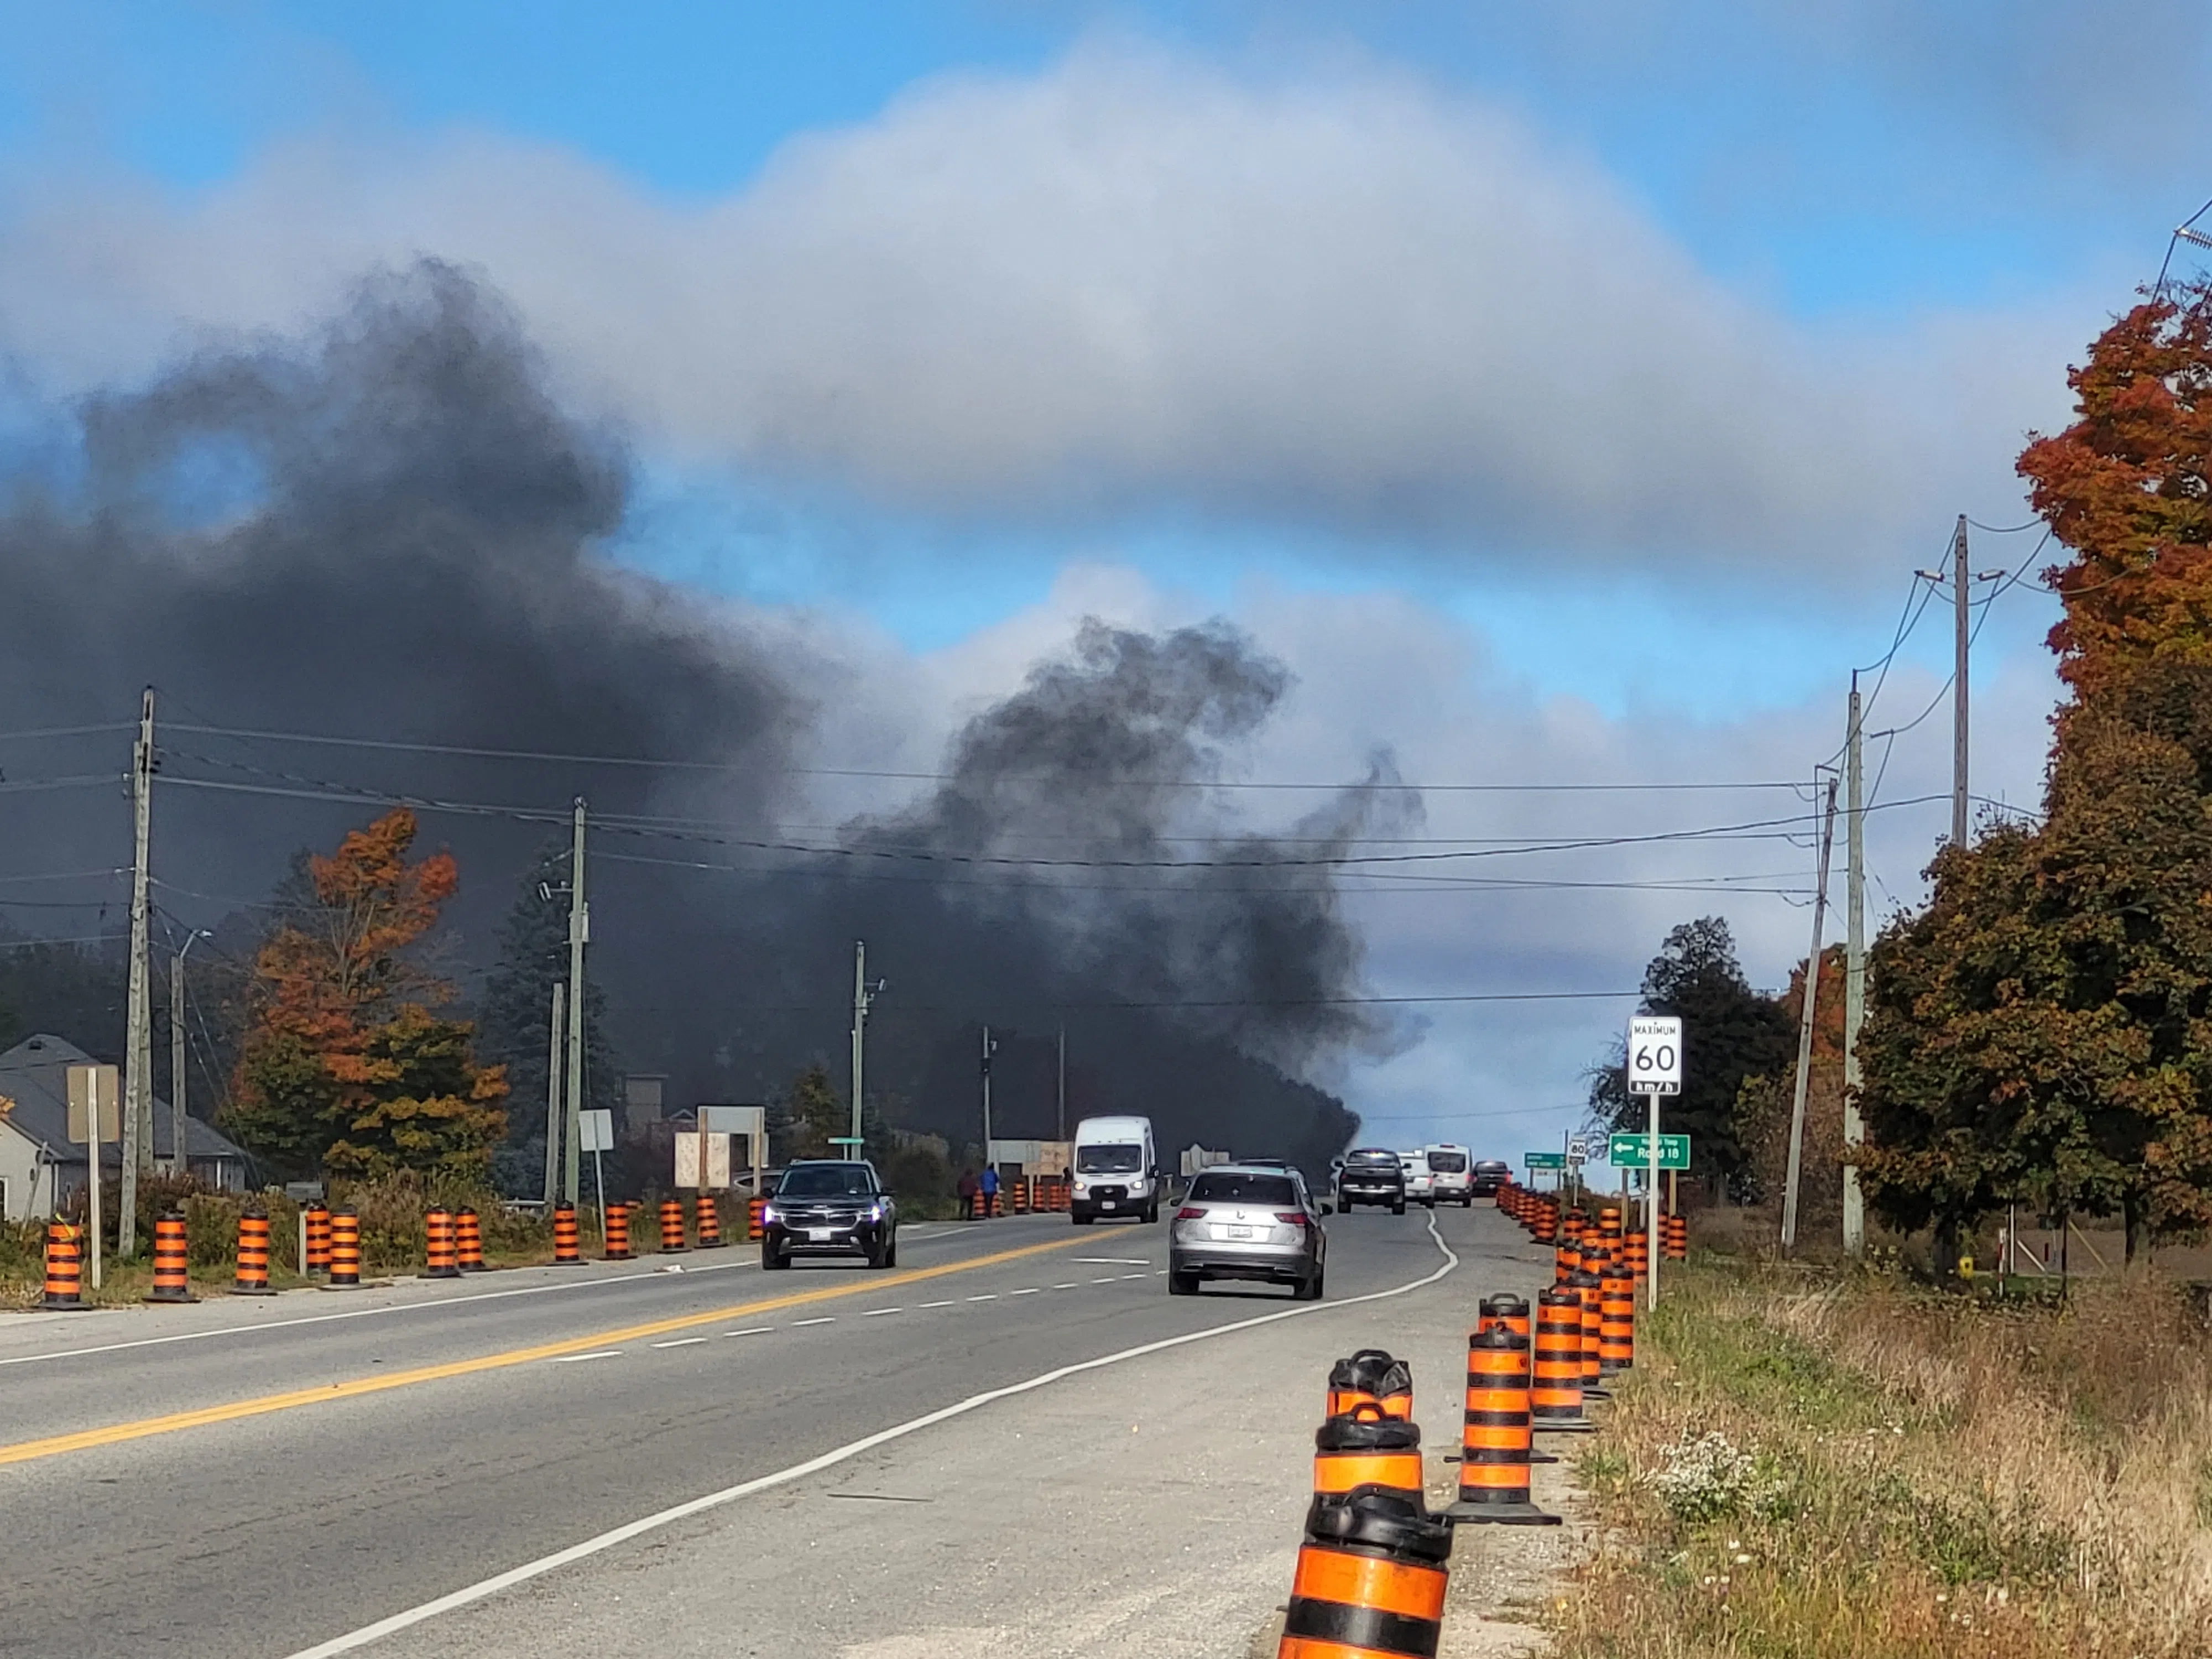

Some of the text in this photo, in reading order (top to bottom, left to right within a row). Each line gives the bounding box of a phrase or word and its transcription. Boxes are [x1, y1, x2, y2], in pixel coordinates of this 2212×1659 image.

[1634, 1025, 1676, 1035] MAXIMUM
[1636, 1045, 1674, 1071] 60
[1636, 1081, 1673, 1092] km/h
[1572, 1144, 1584, 1154] 80
[1668, 1147, 1679, 1159] 18
